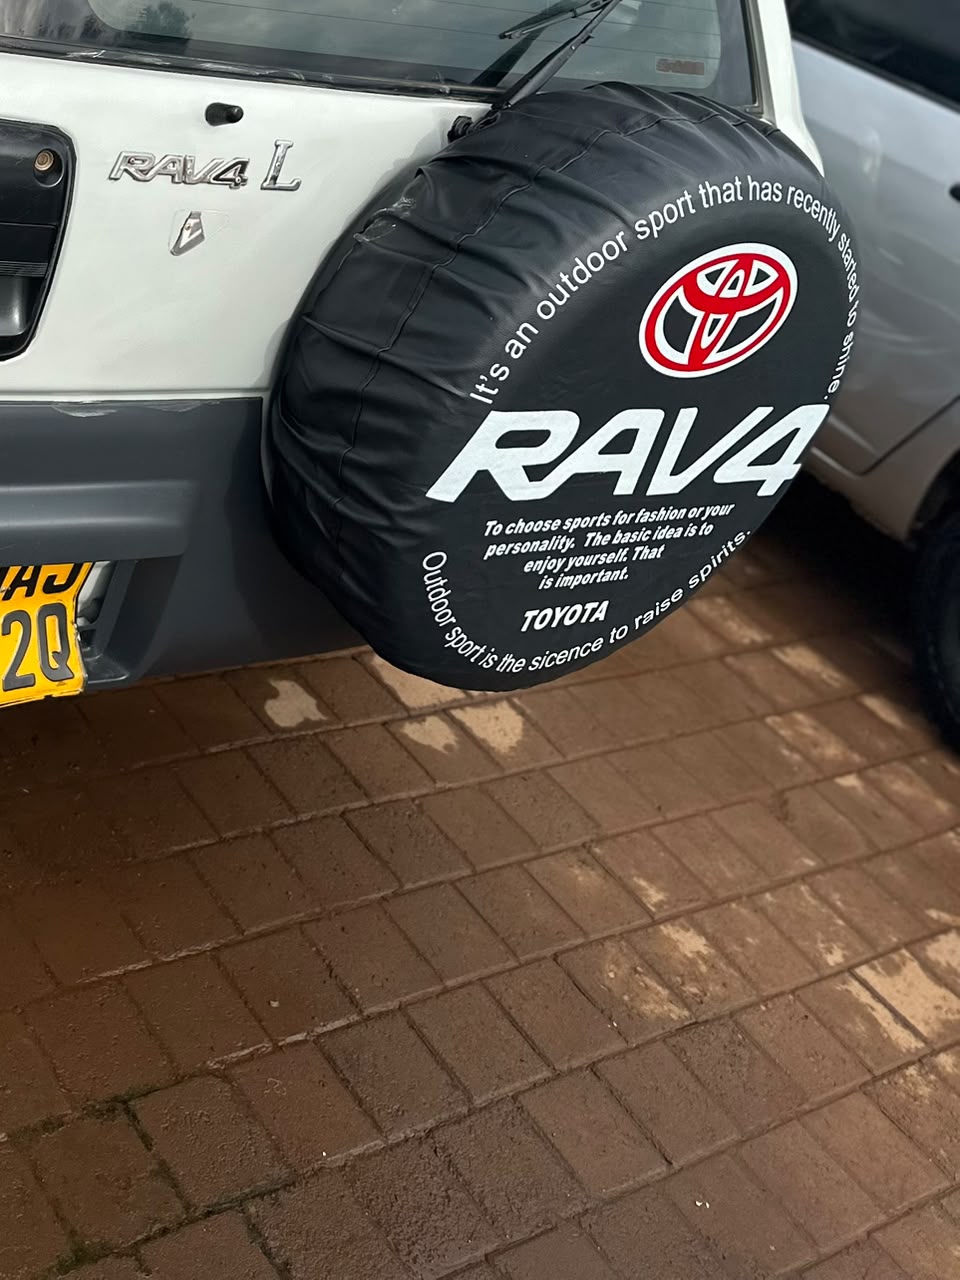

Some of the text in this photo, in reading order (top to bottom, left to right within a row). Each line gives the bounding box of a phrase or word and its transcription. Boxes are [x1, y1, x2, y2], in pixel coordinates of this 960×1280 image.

[108, 138, 303, 192] RAV4 L
[698, 175, 744, 209] that
[746, 174, 783, 203] has
[634, 189, 697, 240] sport
[786, 184, 841, 243] recently
[536, 230, 628, 320] outdoor
[837, 232, 861, 303] started
[846, 300, 860, 328] to
[504, 322, 539, 360] an
[823, 331, 854, 401] shine.
[425, 403, 830, 503] RAV4
[483, 503, 736, 537] To choose sports for fashion or your
[483, 521, 714, 561] personality. The basic idea is to
[523, 544, 666, 575] enjoy yourself. That
[538, 566, 629, 590] is important.
[422, 530, 752, 673] Outdoor sport is the sicence to raise spirits.
[520, 600, 610, 632] TOYOTA
